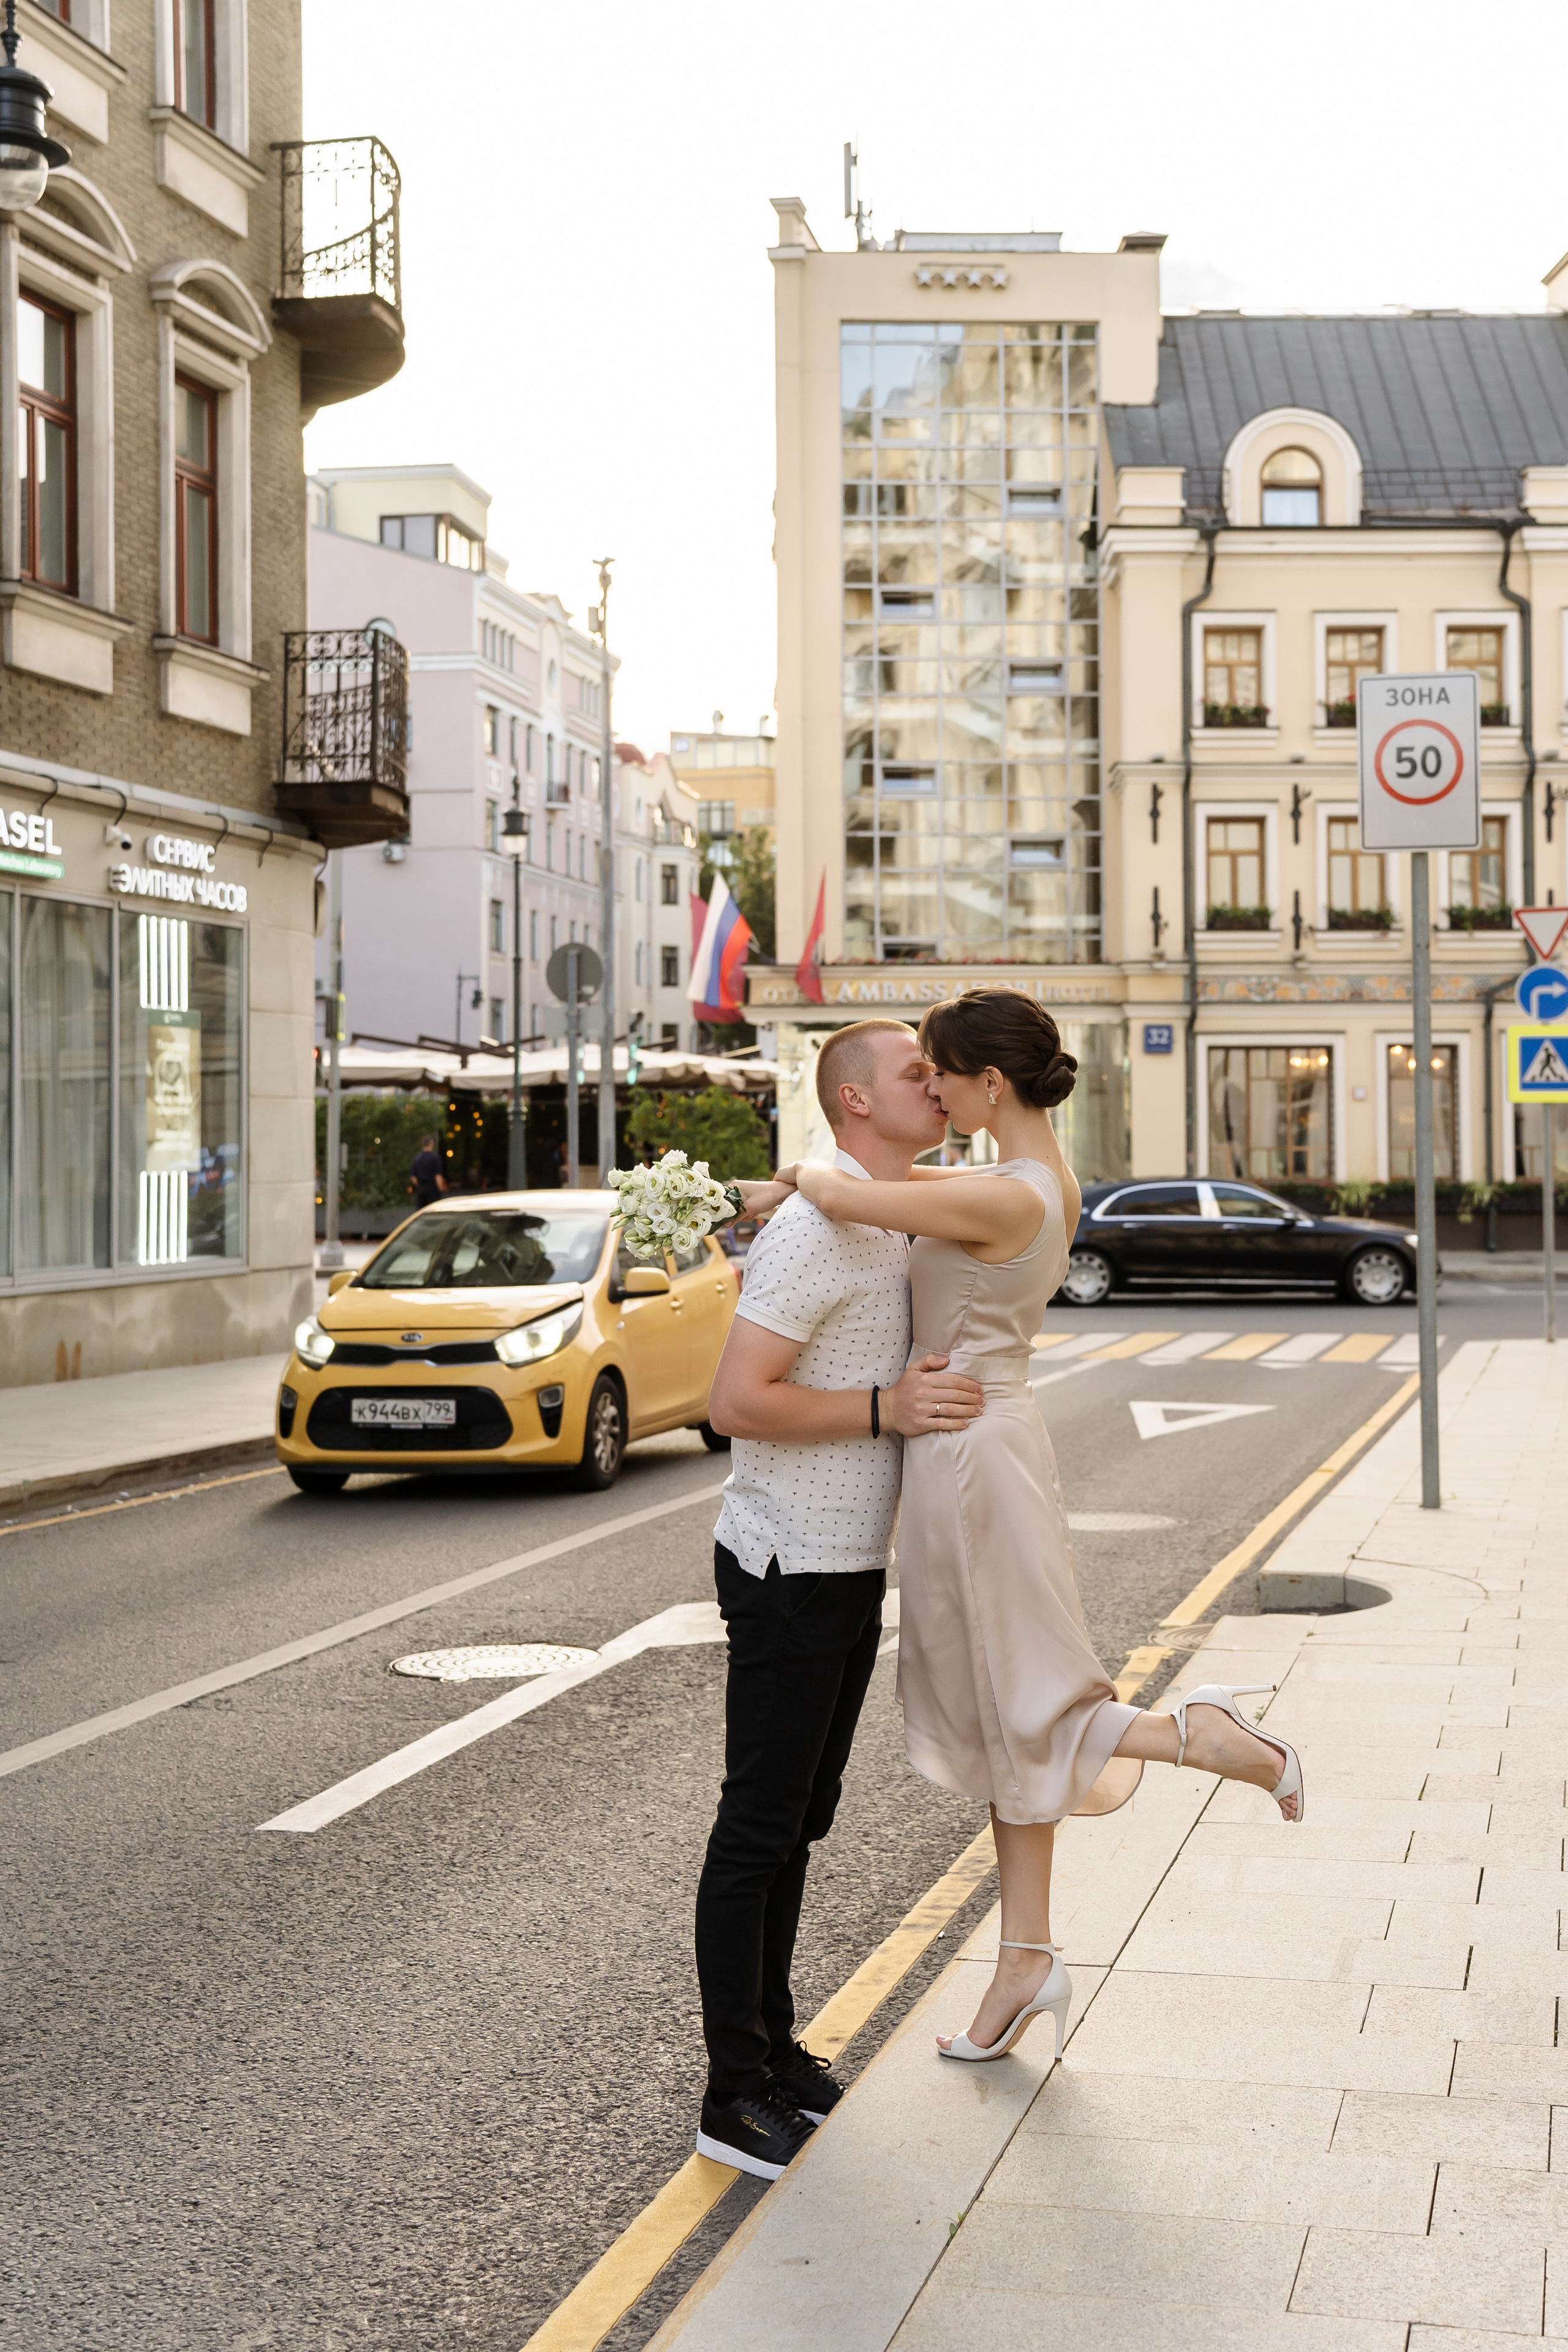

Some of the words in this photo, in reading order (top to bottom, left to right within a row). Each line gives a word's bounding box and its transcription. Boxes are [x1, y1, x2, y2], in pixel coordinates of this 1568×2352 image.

[1385, 686, 1450, 706] ЗОНА
[1395, 744, 1442, 778] 50
[153, 834, 216, 873] СЕРВИС
[117, 863, 195, 903] ЭЛИТНЫХ
[195, 877, 247, 913] ЧАСОВ
[1148, 1028, 1168, 1045] 32
[424, 1401, 450, 1415] 799
